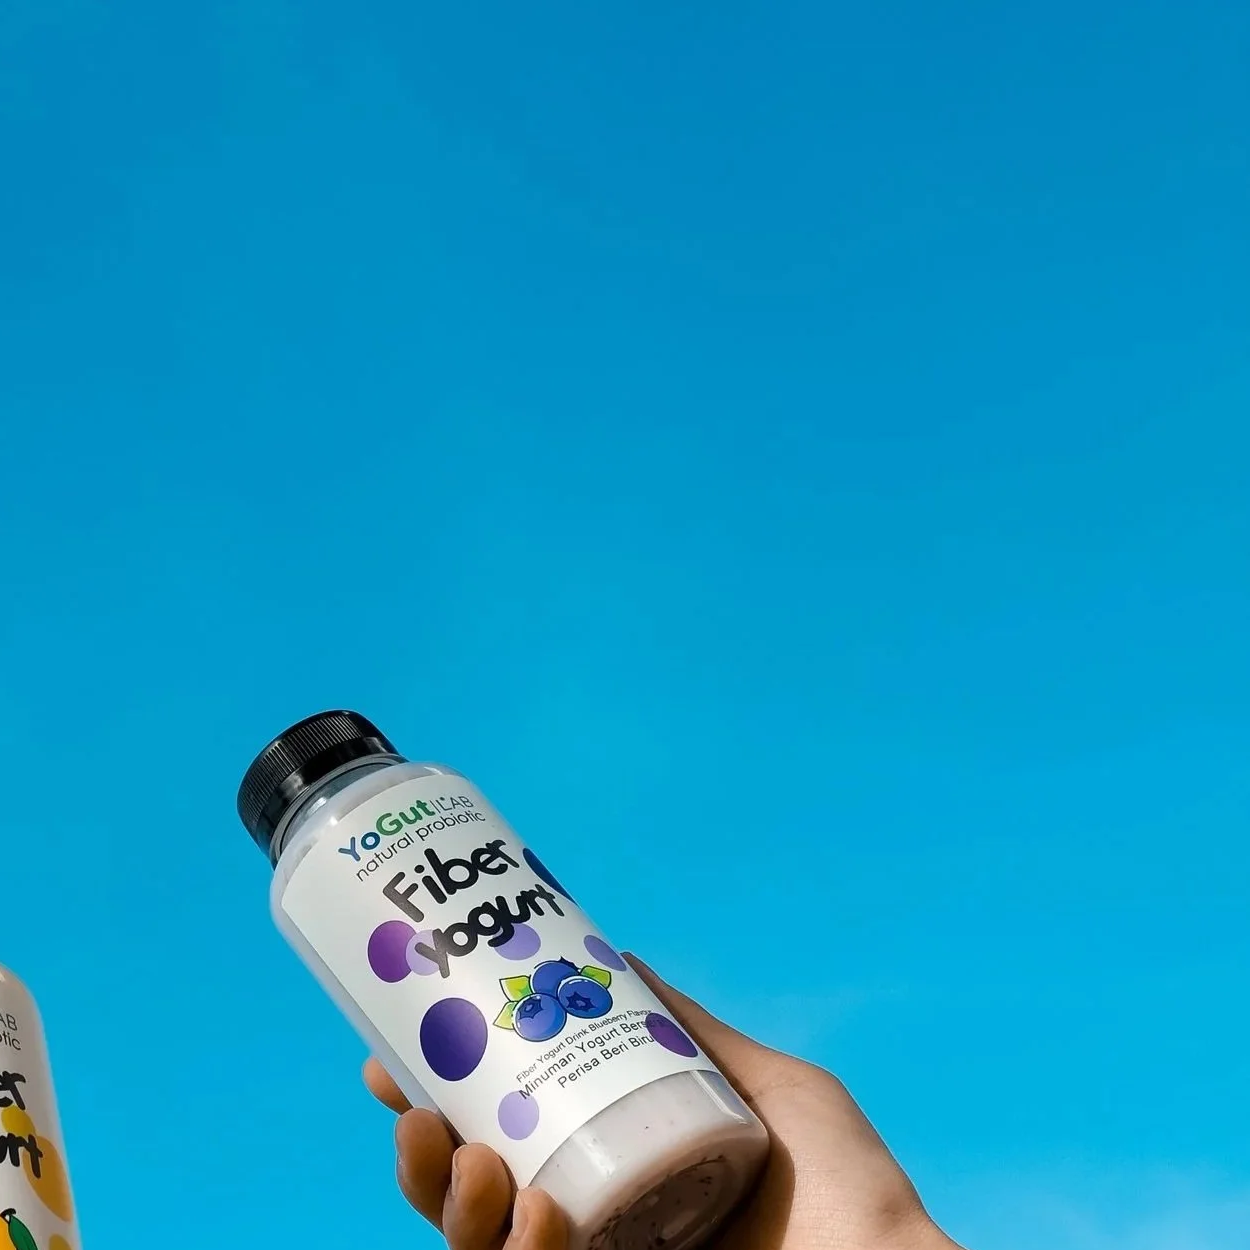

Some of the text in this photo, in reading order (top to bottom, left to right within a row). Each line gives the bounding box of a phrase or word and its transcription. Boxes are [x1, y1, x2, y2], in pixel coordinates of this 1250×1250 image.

[355, 809, 486, 882] natural probiotic
[382, 839, 520, 923] Fiber
[414, 883, 565, 979] yogurt
[516, 1063, 538, 1083] Fiber
[536, 1043, 566, 1063] Yogurt
[565, 1028, 589, 1045] Drink
[588, 1013, 627, 1032] Blueberry
[519, 1051, 576, 1099] Minuman
[575, 1027, 621, 1053] Yogurt
[557, 1032, 655, 1089] Perisa Beri Biru
